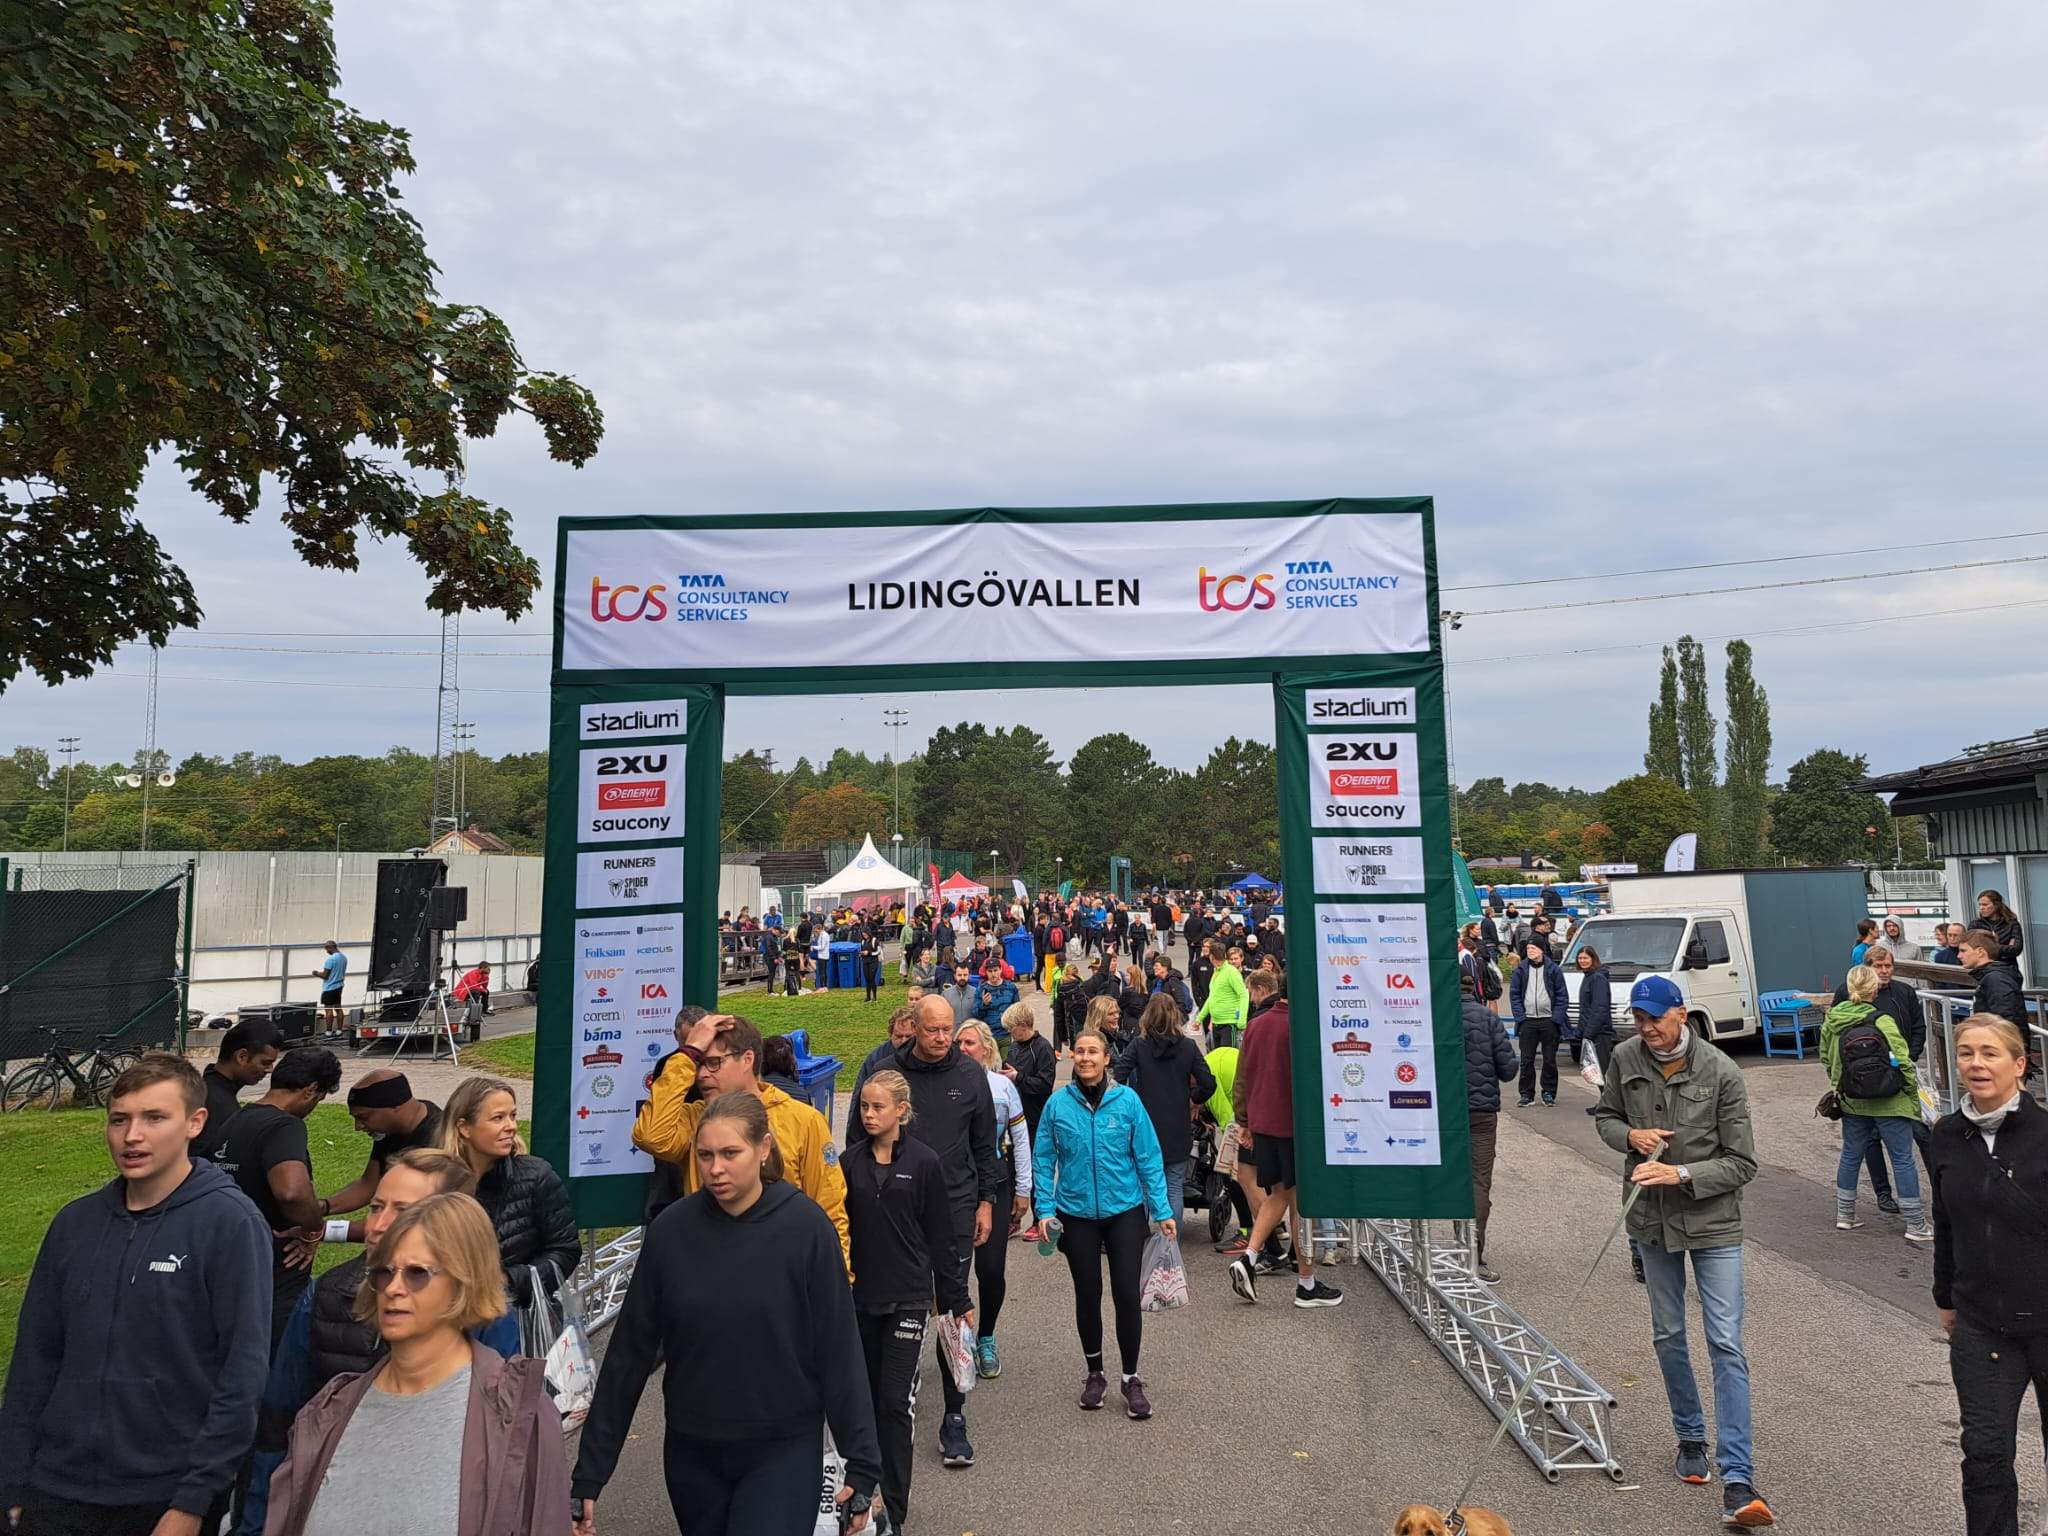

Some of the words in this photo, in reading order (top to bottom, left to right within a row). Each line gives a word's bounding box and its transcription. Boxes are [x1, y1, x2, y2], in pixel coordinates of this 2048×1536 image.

[1285, 561, 1334, 574] TATA
[678, 574, 725, 588] TATA
[1285, 576, 1400, 592] CONSULTANCY
[848, 570, 1141, 611] LIDINGÖVALLEN
[1199, 567, 1276, 613] tcs
[591, 575, 668, 622] tcs
[677, 590, 790, 605] CONSULTANCY
[1286, 594, 1358, 610] SERVICES
[677, 607, 749, 622] SERVICES
[1313, 698, 1407, 717] stadium
[586, 711, 679, 732] stadium
[1326, 742, 1397, 761] 2XU
[597, 754, 667, 775] 2XU
[1351, 775, 1393, 785] ENERVIT
[621, 787, 661, 799] ENERVIT
[1326, 805, 1406, 820] saucony
[592, 816, 671, 832] saucony
[1339, 845, 1393, 856] RUNNERS
[604, 857, 656, 870] RUNNERS
[1361, 865, 1386, 876] SPIDER
[624, 876, 649, 888] SPIDER
[1361, 875, 1378, 886] ADS.
[624, 888, 639, 899] ADS.
[1327, 934, 1368, 944] Folksam
[585, 948, 626, 958] Folksam
[1327, 955, 1361, 966] VING
[584, 968, 618, 980] VING
[1386, 973, 1415, 989] ICA
[641, 983, 668, 999] ICA
[1329, 999, 1368, 1009] corem
[583, 1011, 620, 1022] corem
[149, 1261, 177, 1273] PUMA
[820, 1465, 836, 1514] 68078
